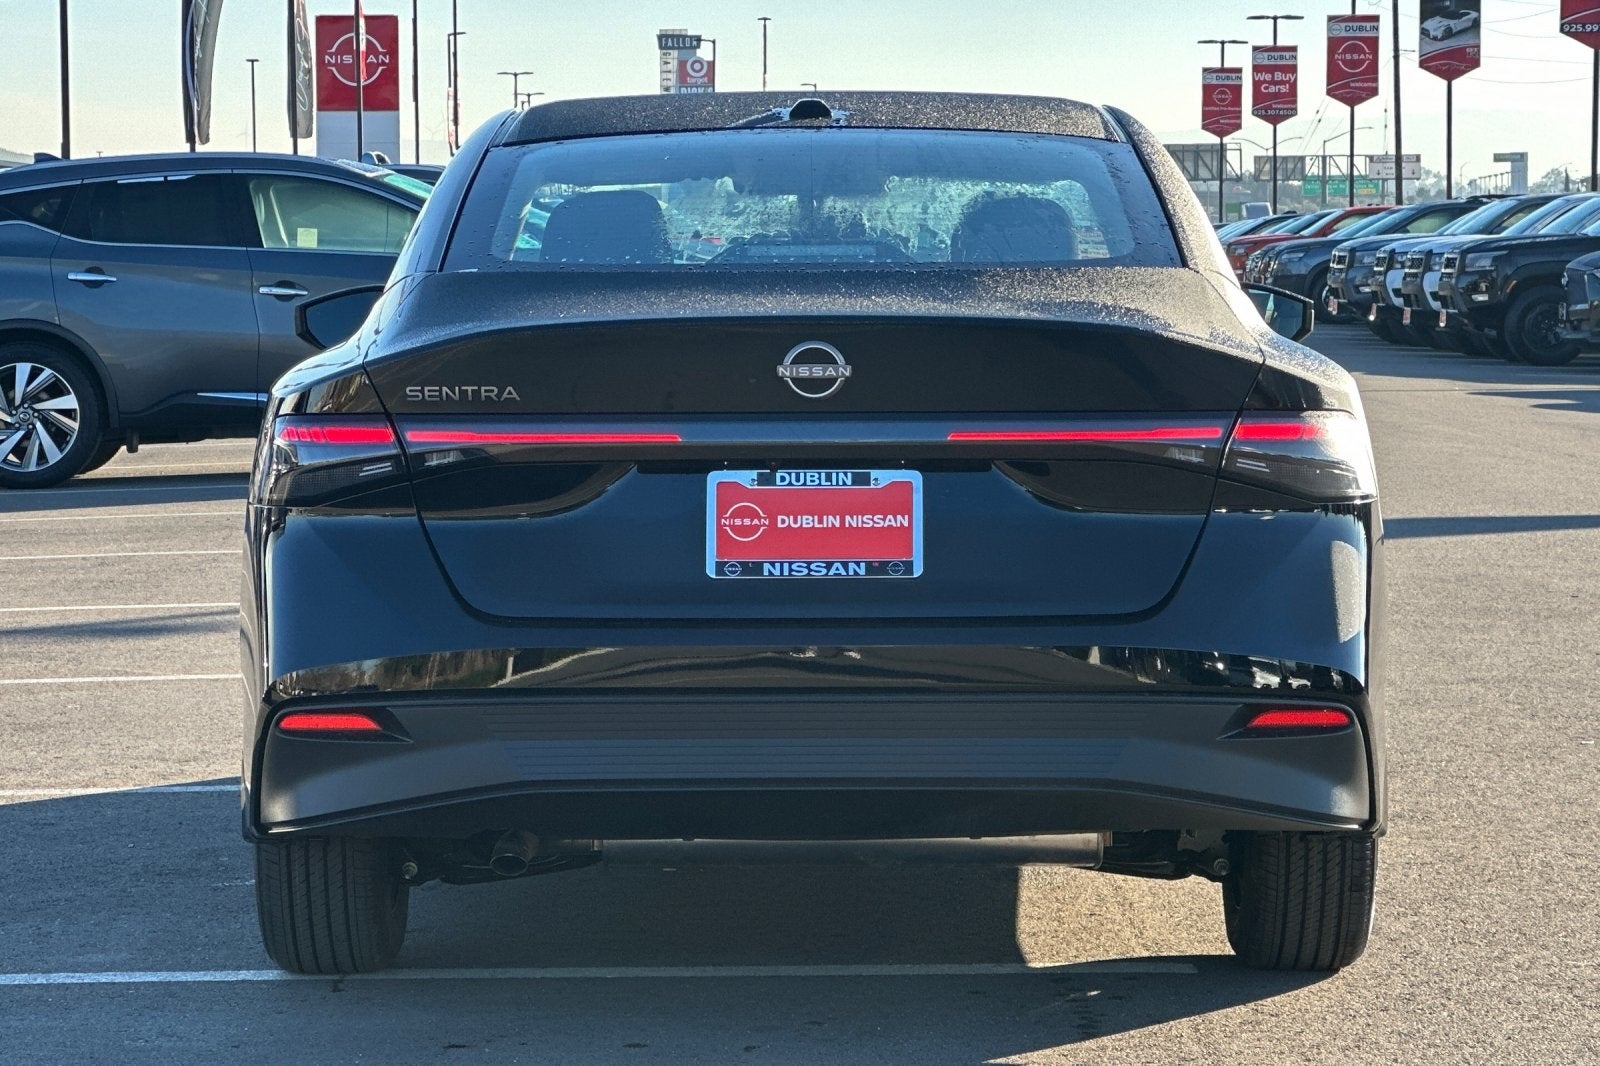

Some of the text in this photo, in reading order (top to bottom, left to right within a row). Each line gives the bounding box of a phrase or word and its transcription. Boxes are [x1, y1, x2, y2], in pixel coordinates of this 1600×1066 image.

[1563, 23, 1600, 32] 925.99
[662, 37, 698, 47] FALLON
[324, 54, 390, 64] NISAN
[1253, 71, 1297, 83] We Buy
[1260, 83, 1290, 93] Cars!
[777, 365, 852, 378] NISSAN
[405, 386, 521, 402] SENTRA
[775, 472, 853, 486] DUBLIN
[721, 518, 769, 526] NISSAN
[777, 515, 909, 528] DUBLIN NISSAN
[762, 562, 866, 576] NISSAN
